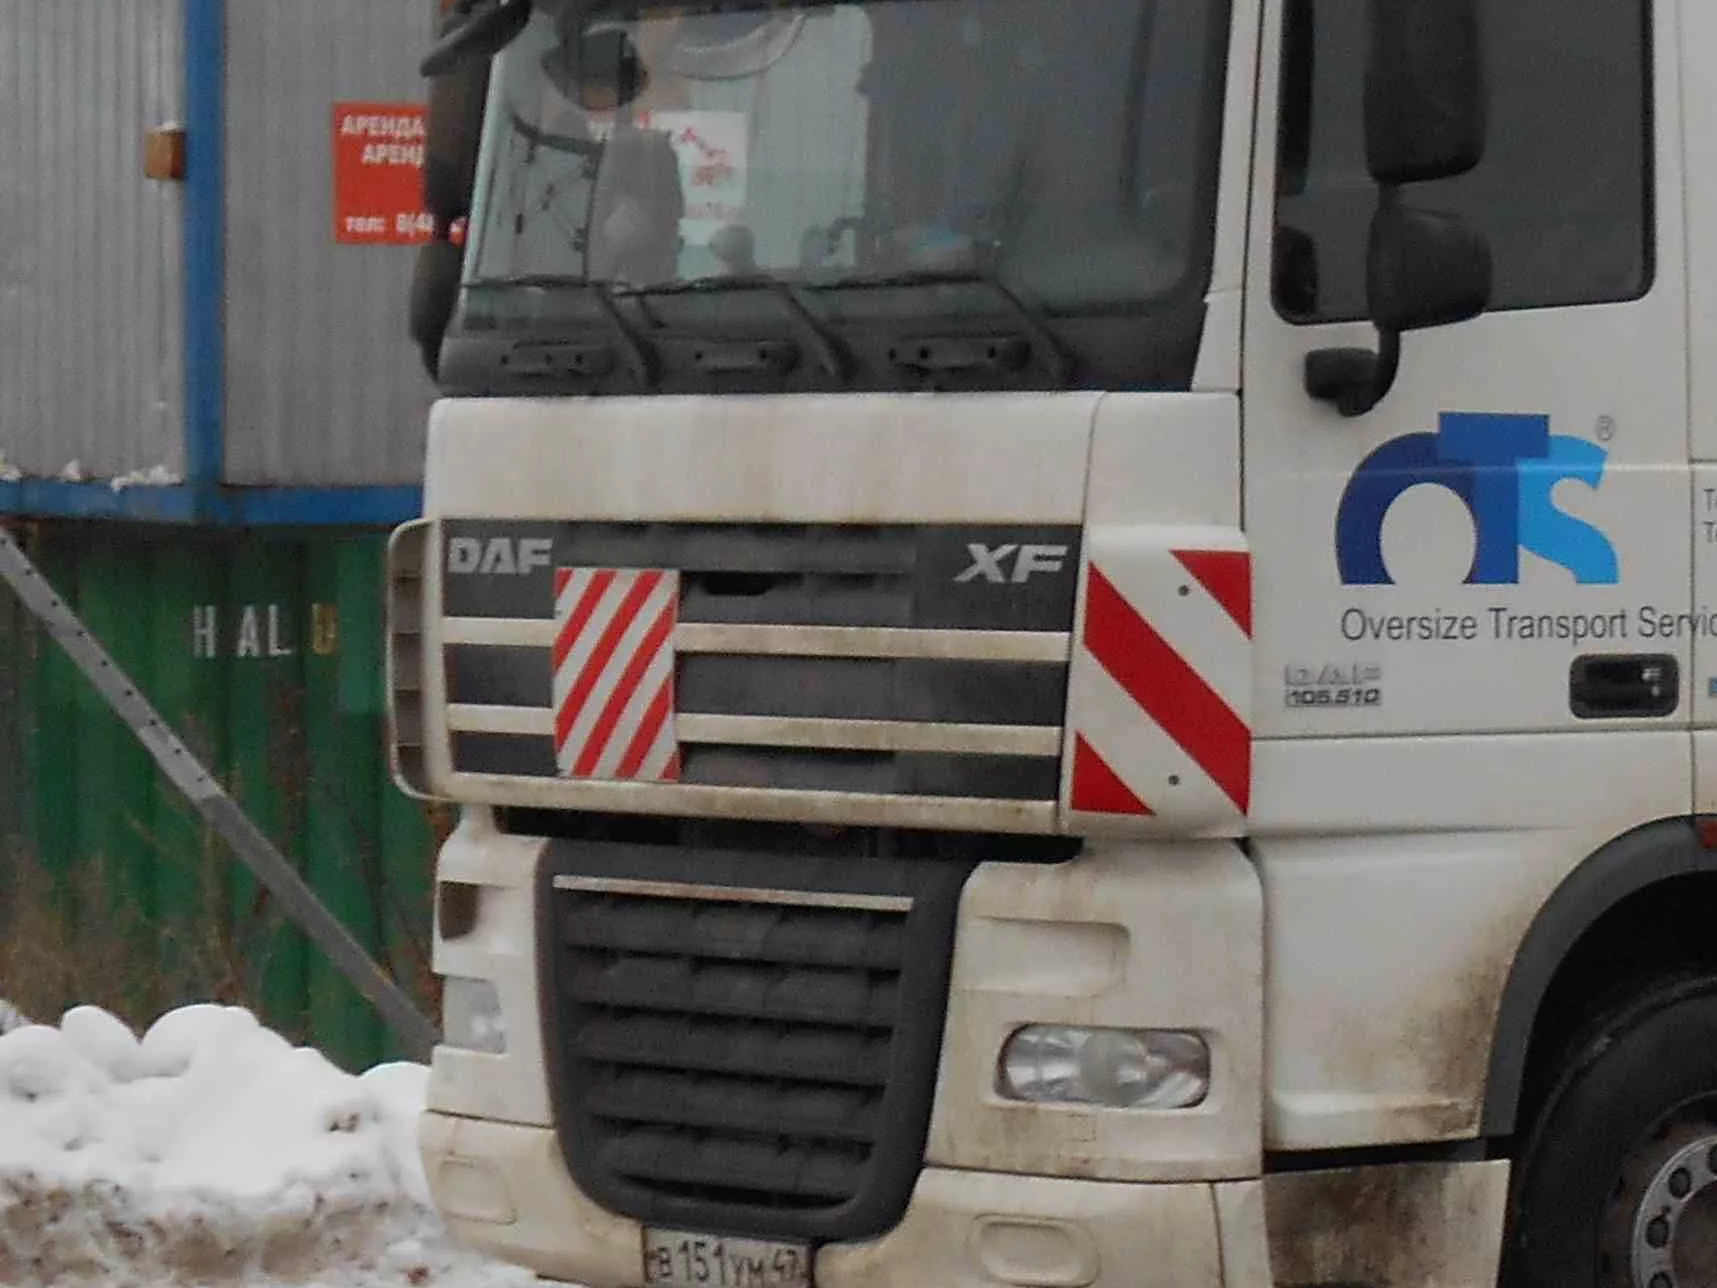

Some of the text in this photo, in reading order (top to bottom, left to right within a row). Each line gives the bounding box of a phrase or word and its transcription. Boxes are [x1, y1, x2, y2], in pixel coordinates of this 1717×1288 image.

[448, 536, 552, 576] DAF
[953, 543, 1068, 585] XF
[1341, 608, 1477, 642] Oversize
[1489, 607, 1628, 646] Transport
